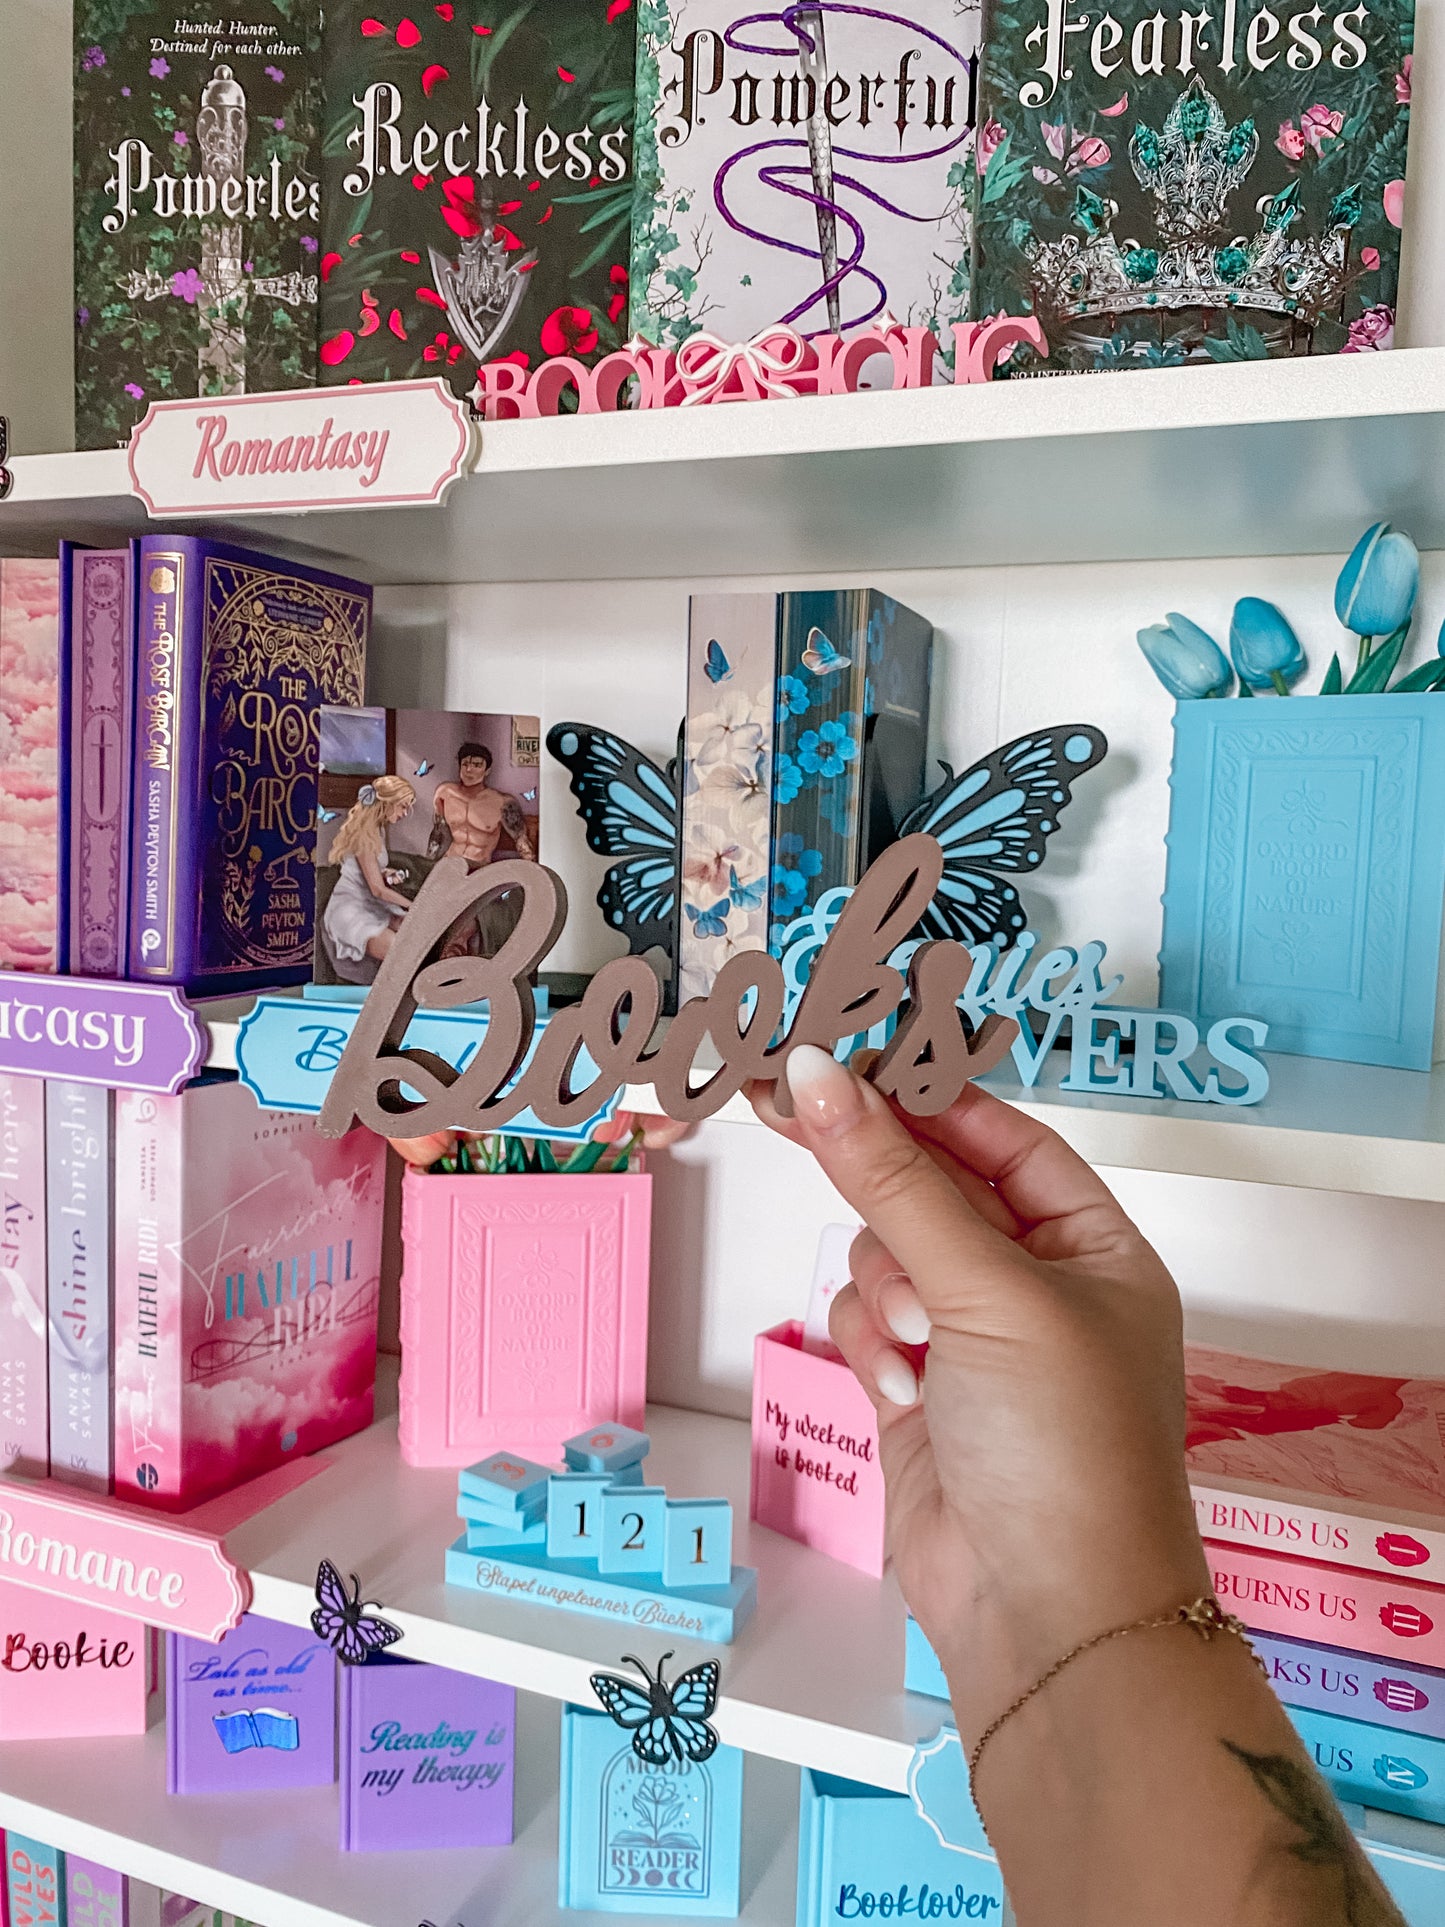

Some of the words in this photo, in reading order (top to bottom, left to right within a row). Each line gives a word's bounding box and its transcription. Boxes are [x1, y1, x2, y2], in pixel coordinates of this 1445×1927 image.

[150, 37, 209, 53] Destined
[209, 40, 233, 61] for
[235, 39, 262, 55] each
[266, 40, 303, 56] other.
[173, 19, 224, 35] Hunted.
[228, 20, 279, 36] Hunter.
[1018, 0, 1371, 109] Fearless
[659, 28, 980, 152] Powerful
[342, 82, 629, 197] Reckless
[192, 415, 390, 487] Romantasy
[153, 602, 167, 630] THE
[146, 632, 174, 687] ROSE
[279, 676, 307, 700] THE
[147, 779, 161, 822] SASHA
[210, 760, 318, 858] BARG
[146, 823, 160, 877] PEYTON
[145, 879, 159, 919] SMITH
[261, 911, 305, 929] PEYTON
[267, 894, 301, 911] SASHA
[266, 930, 300, 948] SMITH
[316, 832, 1020, 1138] Books
[60, 1094, 99, 1217] bright
[1, 1191, 33, 1269] stay
[62, 1230, 88, 1341] shine
[137, 1270, 157, 1358] HATEFUL
[2, 1360, 12, 1420] ANNA
[15, 1359, 26, 1426] SAVAS
[68, 1372, 79, 1432] ANNA
[81, 1371, 92, 1439] SAVAS
[766, 1399, 791, 1441] My
[70, 1454, 89, 1471] LYX
[775, 1445, 790, 1469] is
[795, 1449, 858, 1496] booked
[1211, 1503, 1303, 1542] BINDS
[1310, 1521, 1350, 1551] US
[476, 1561, 536, 1593] Stapel
[536, 1576, 630, 1616] ungelesener
[1213, 1571, 1311, 1613] BURNS
[1318, 1592, 1357, 1622] US
[1, 1632, 134, 1672] Bookie
[184, 1649, 264, 1682] Tale
[1320, 1667, 1360, 1697] US
[360, 1720, 477, 1755] Reading
[484, 1721, 507, 1745] is
[1314, 1742, 1354, 1773] US
[361, 1765, 404, 1796] my
[412, 1756, 507, 1791] therapy
[611, 1849, 699, 1870] READER
[835, 1884, 1000, 1919] Booklover
